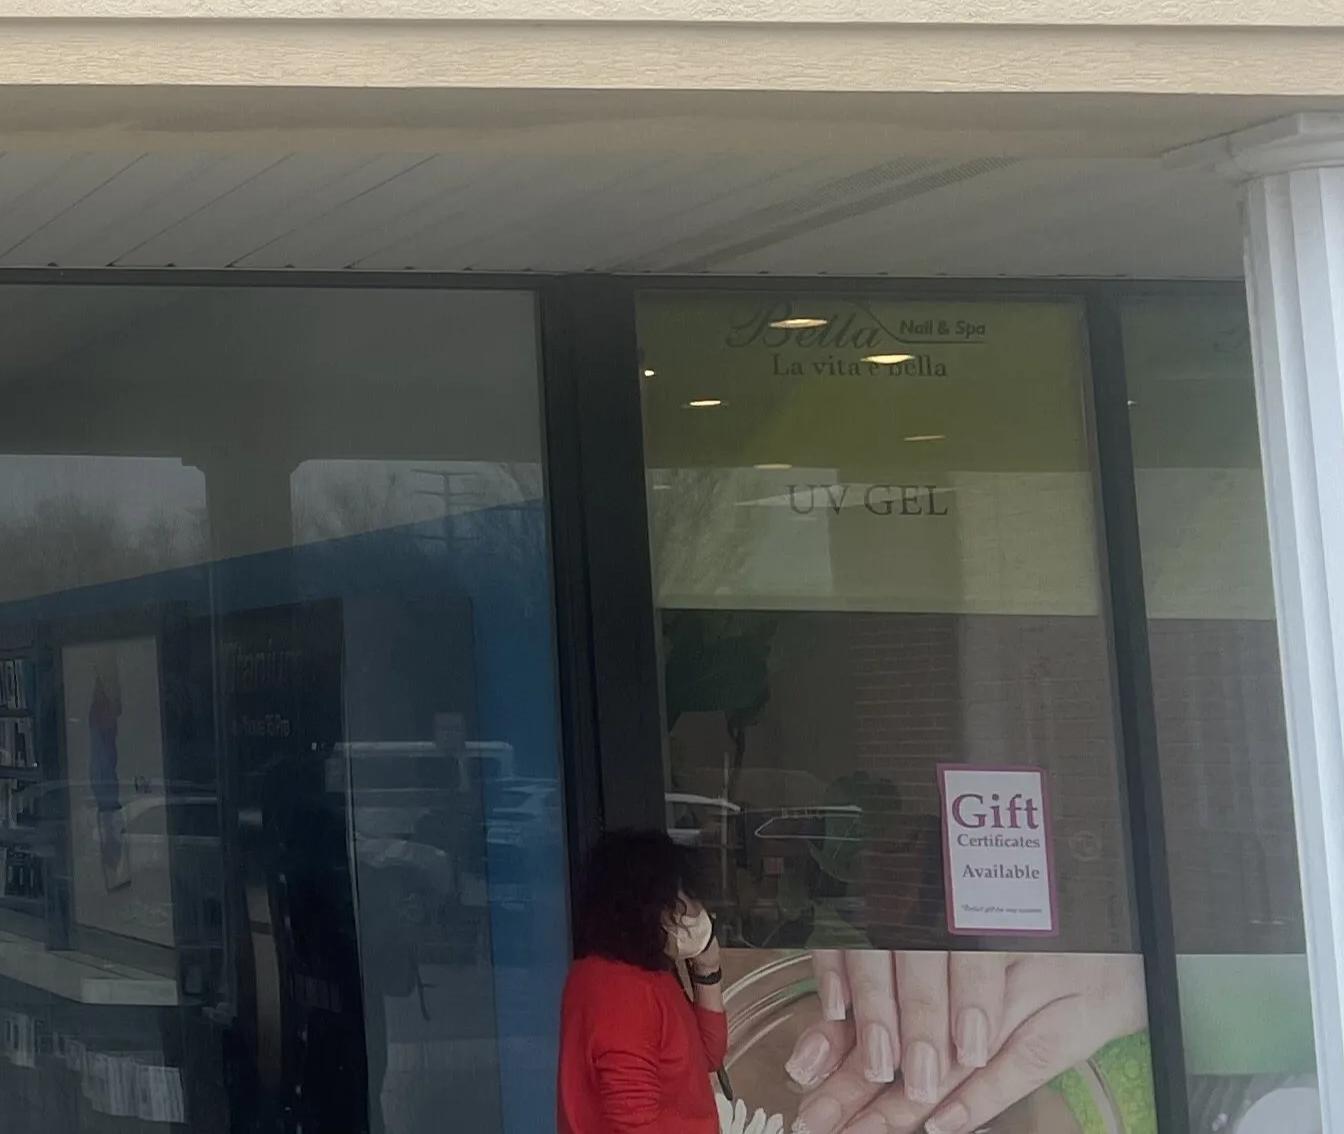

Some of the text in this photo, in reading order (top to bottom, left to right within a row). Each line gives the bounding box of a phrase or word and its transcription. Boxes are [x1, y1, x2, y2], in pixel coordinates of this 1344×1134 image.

[900, 319, 987, 340] Nail & Spa
[772, 352, 804, 377] La
[812, 354, 862, 377] vita
[785, 484, 949, 516] UV GEL
[951, 793, 1040, 830] Gift
[957, 833, 1041, 848] Certificates
[962, 864, 1041, 880] Available
